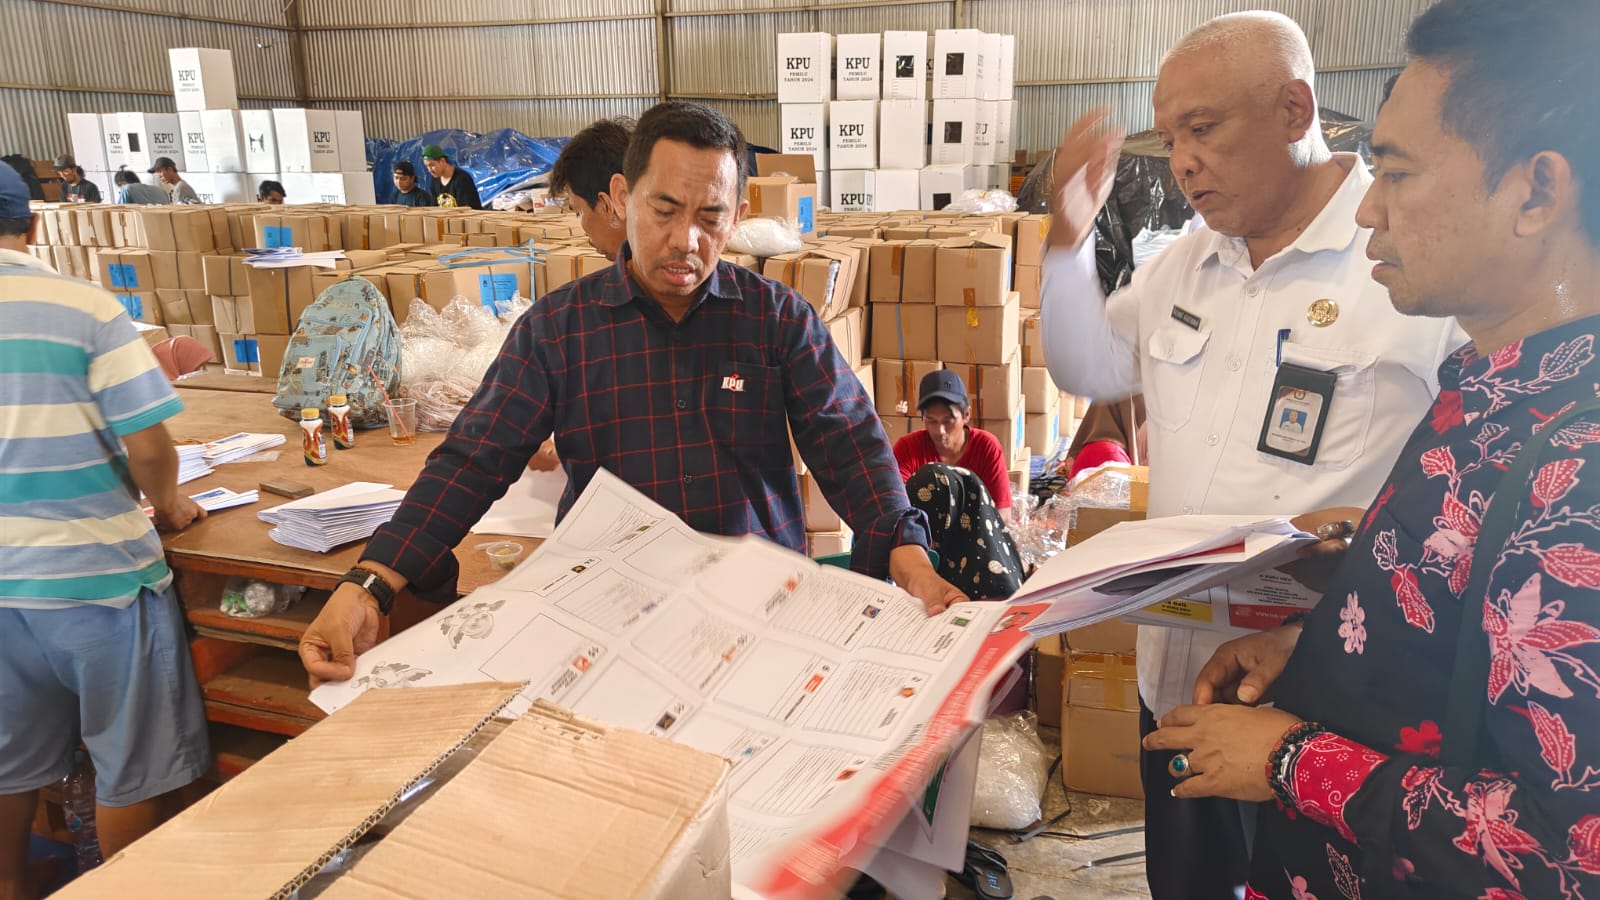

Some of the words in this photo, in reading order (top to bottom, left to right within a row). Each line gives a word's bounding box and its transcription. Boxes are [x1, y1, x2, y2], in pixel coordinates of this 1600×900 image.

[786, 57, 811, 70] KPU
[845, 57, 870, 70] KPU
[178, 69, 196, 81] KPU
[790, 127, 814, 140] KPU
[839, 124, 864, 136] KPU
[109, 133, 121, 144] KP
[153, 132, 174, 144] KPU
[187, 132, 205, 144] KPU
[313, 131, 331, 143] KPU
[840, 193, 865, 206] KPU
[721, 376, 745, 392] KPU
